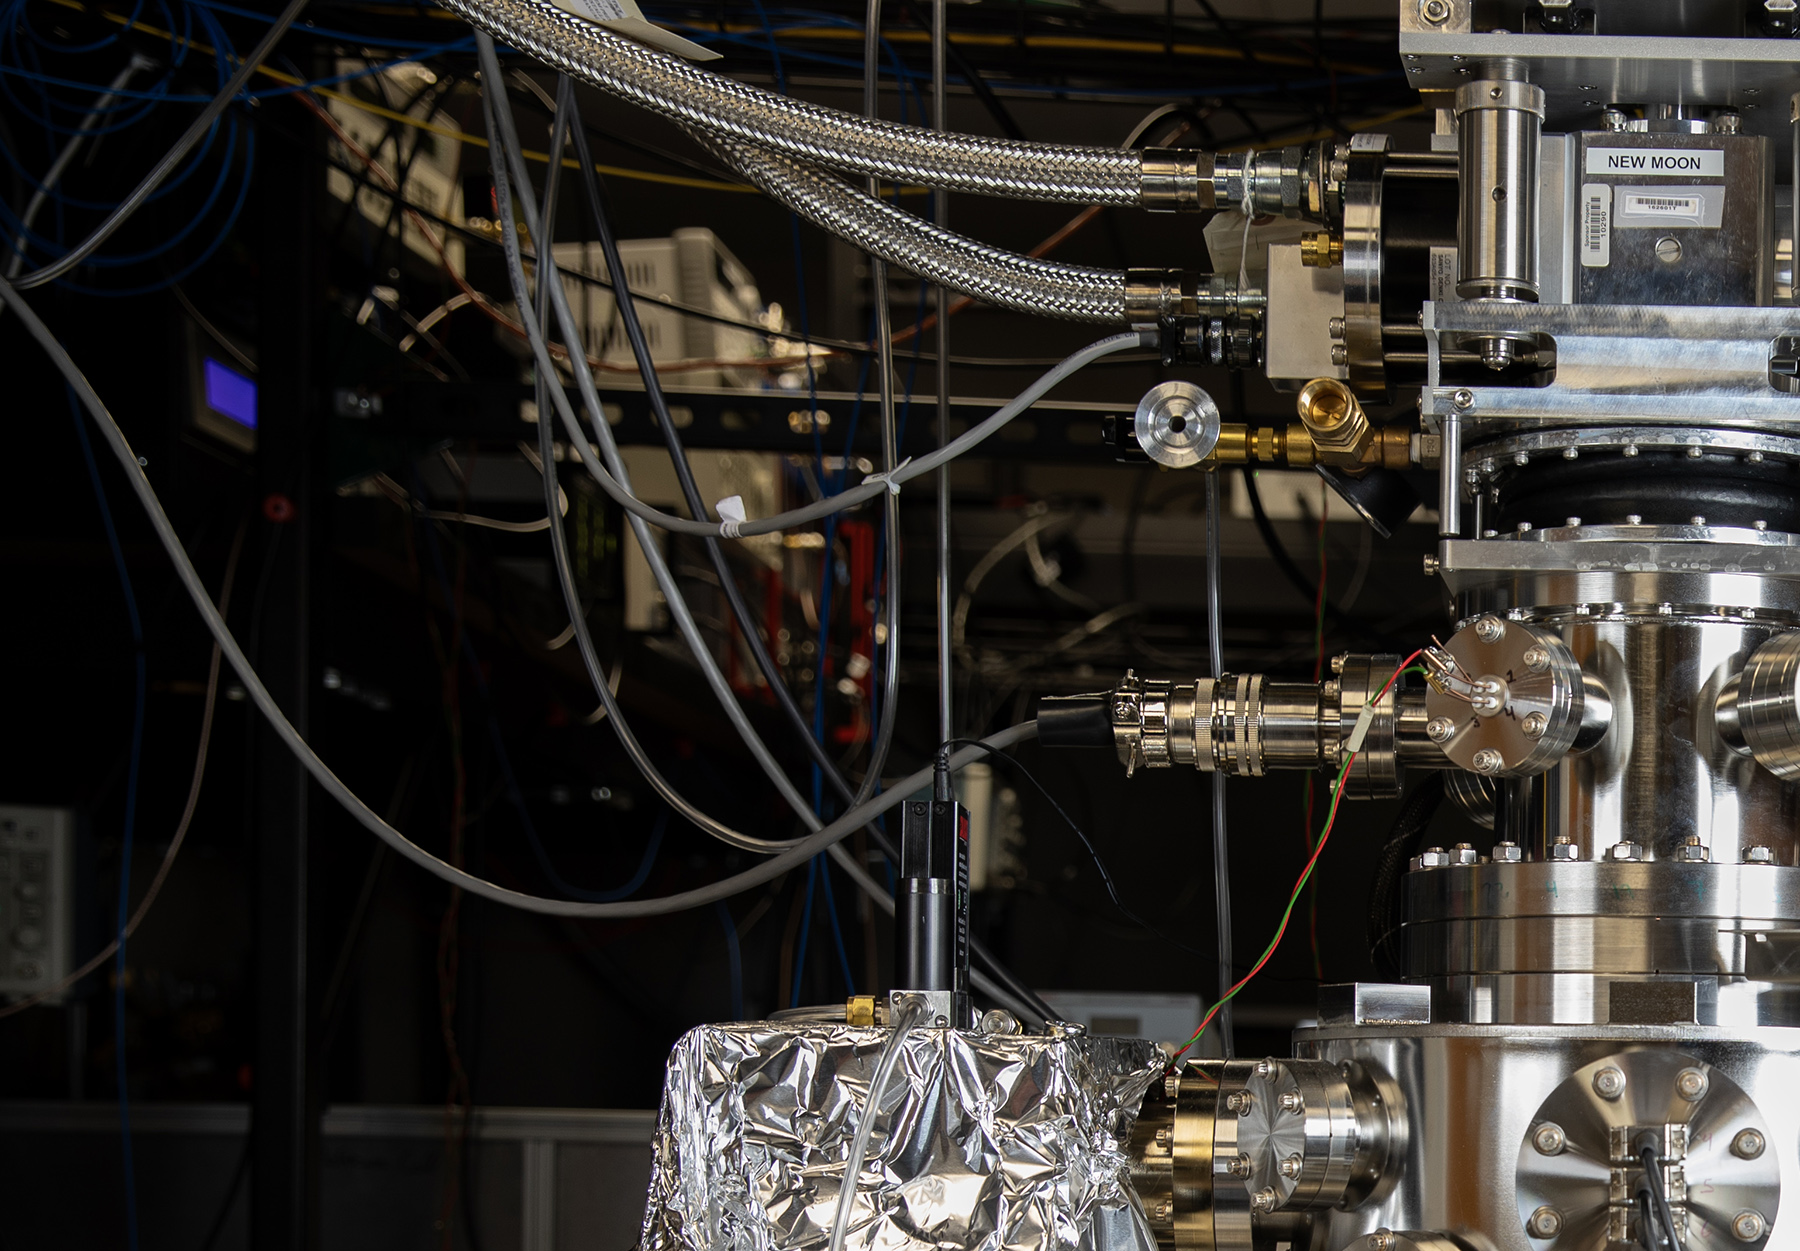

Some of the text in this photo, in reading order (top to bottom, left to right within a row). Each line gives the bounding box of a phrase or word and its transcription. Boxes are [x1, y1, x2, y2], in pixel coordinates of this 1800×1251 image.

[1608, 155, 1701, 170] NEW MOON
[1504, 705, 1516, 721] 4
